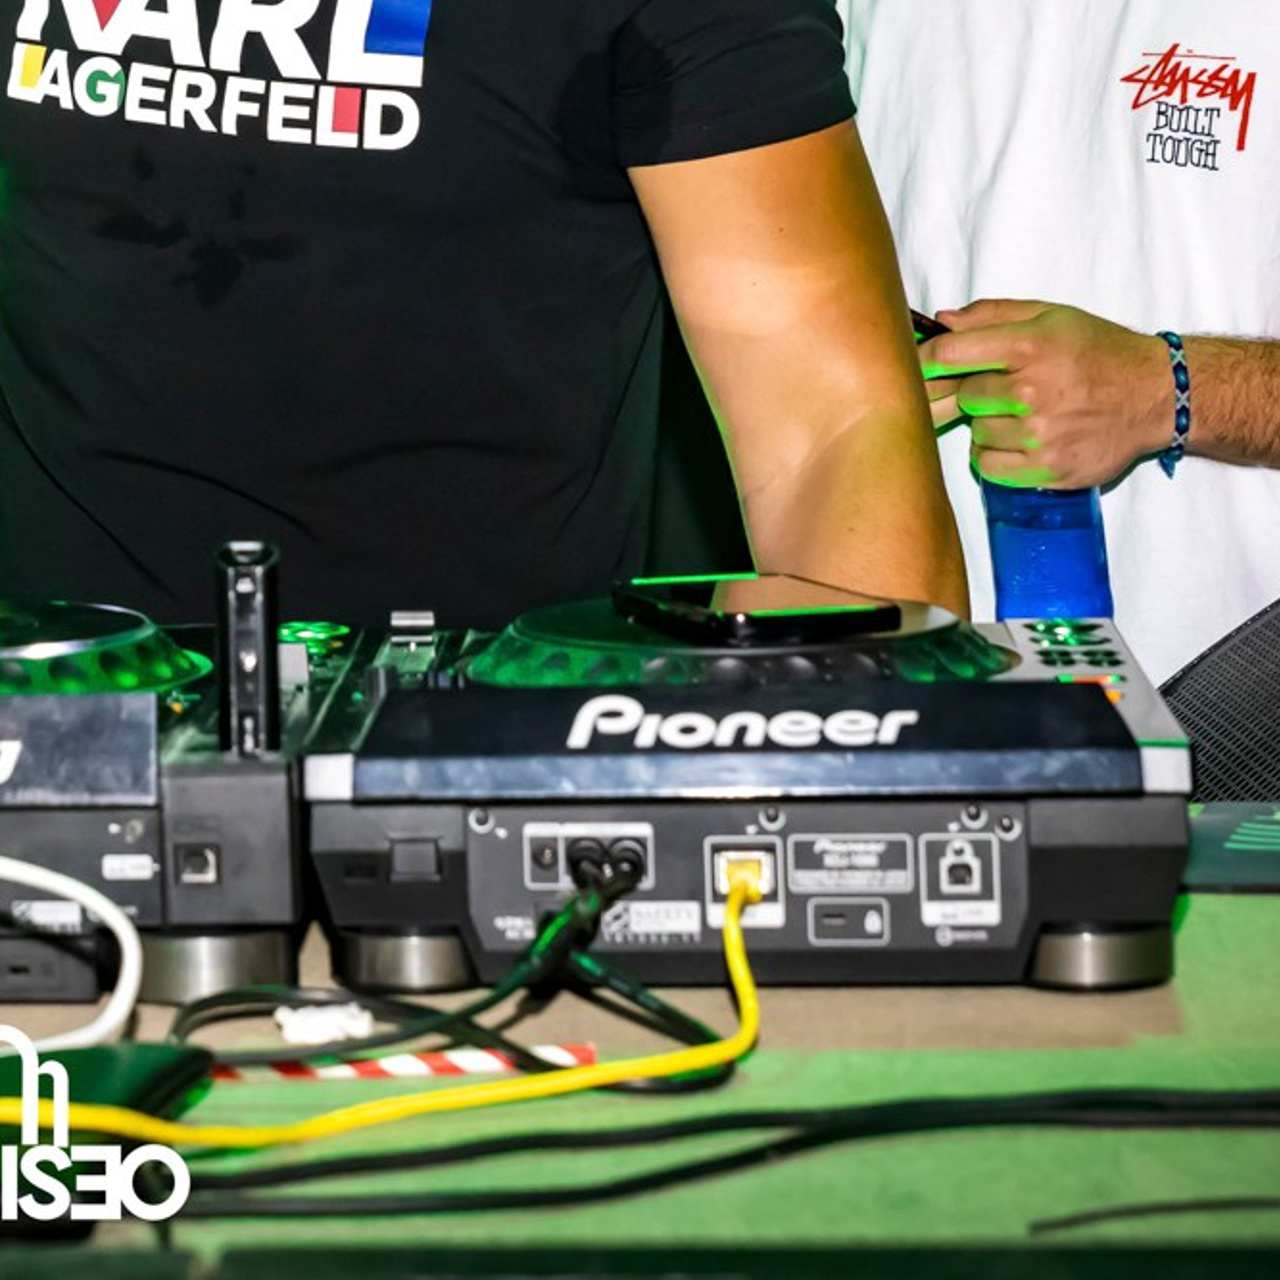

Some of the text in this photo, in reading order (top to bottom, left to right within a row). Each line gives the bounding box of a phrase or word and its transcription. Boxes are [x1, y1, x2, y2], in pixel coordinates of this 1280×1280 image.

[7, 41, 421, 151] LAGERFELD
[1153, 100, 1221, 137] BUILT
[1146, 132, 1221, 171] TOUGH
[566, 695, 918, 749] Pioneer
